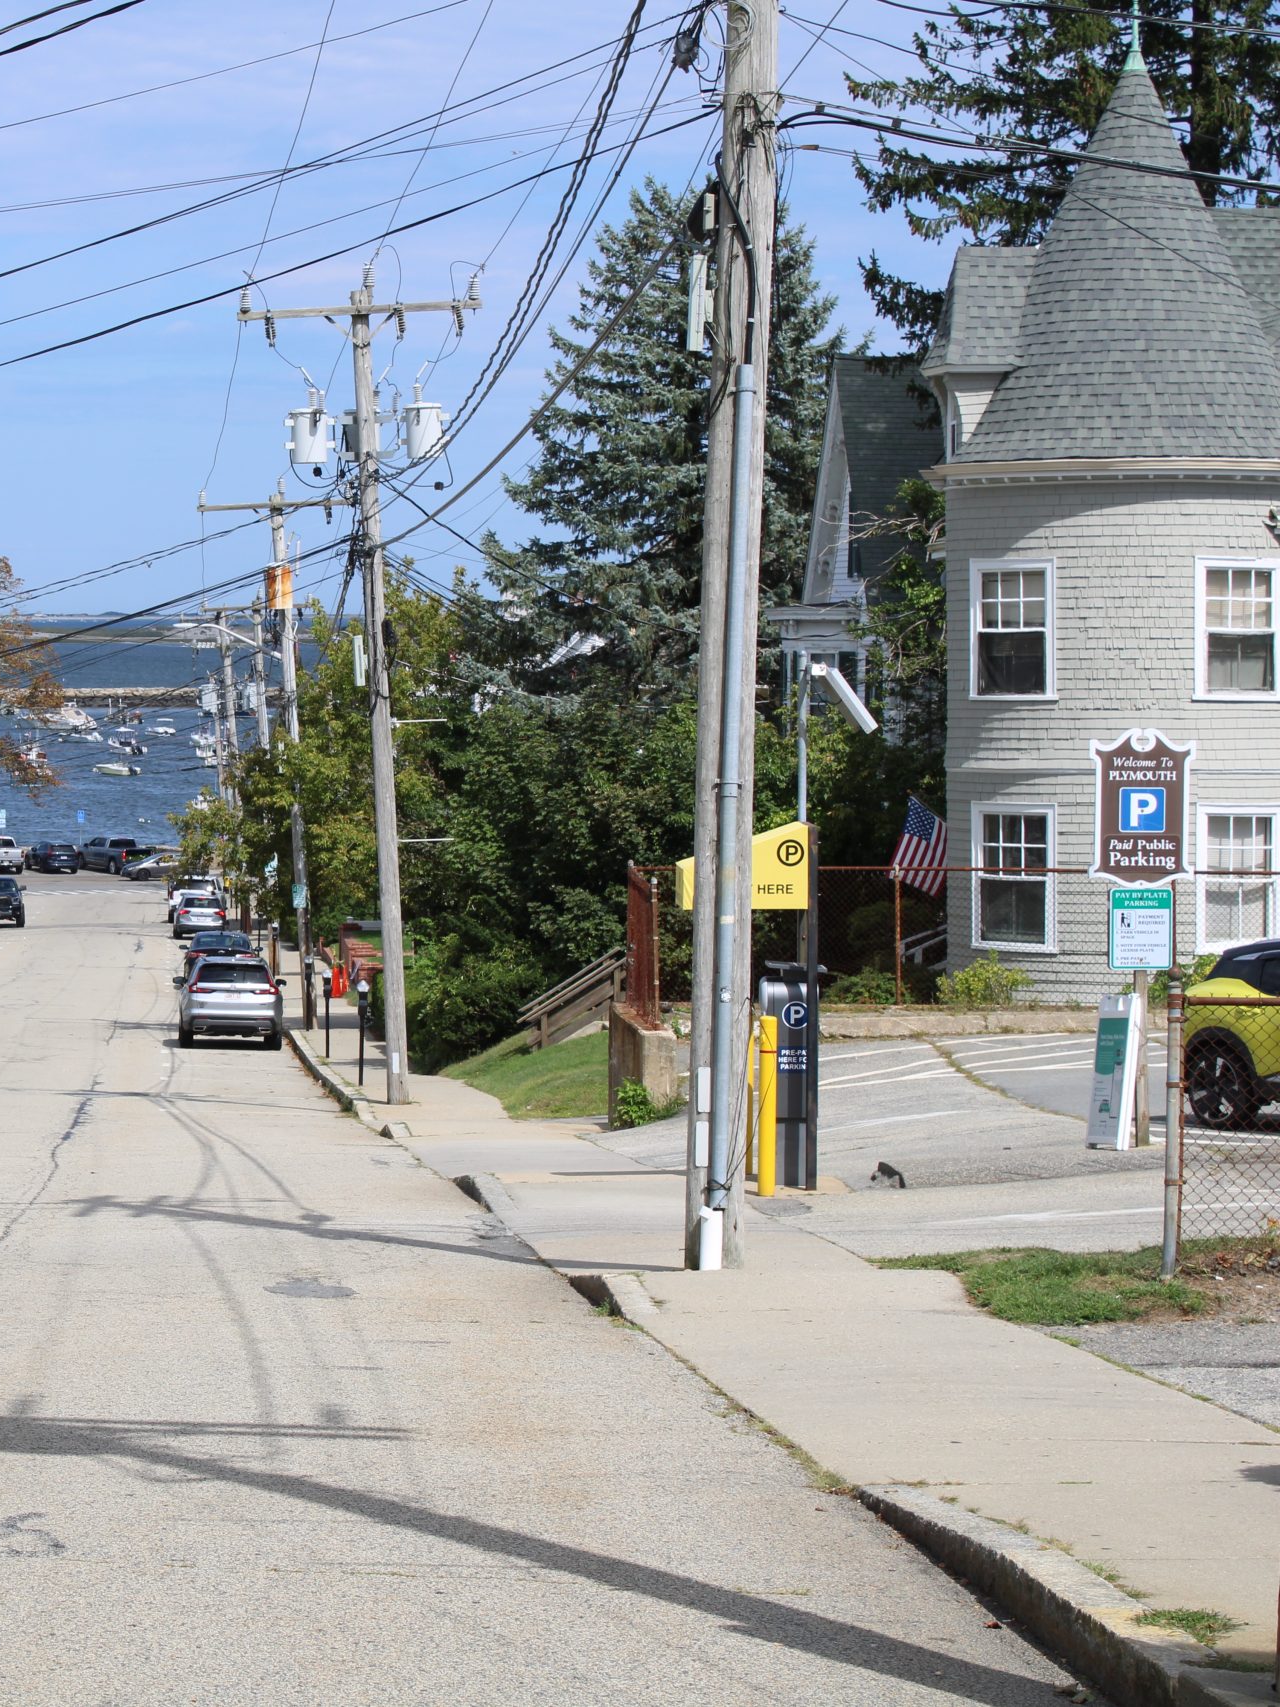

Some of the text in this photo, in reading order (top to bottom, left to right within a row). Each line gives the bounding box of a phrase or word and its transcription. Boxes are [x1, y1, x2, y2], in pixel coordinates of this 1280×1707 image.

[1113, 756, 1174, 767] Welcome To
[1109, 770, 1177, 781] PLYMOUTH
[1130, 793, 1158, 827] P
[1109, 839, 1176, 850] Paid Public
[786, 845, 798, 861] P
[1109, 851, 1176, 870] Parking
[757, 884, 794, 894] HERE
[790, 1006, 805, 1024] P
